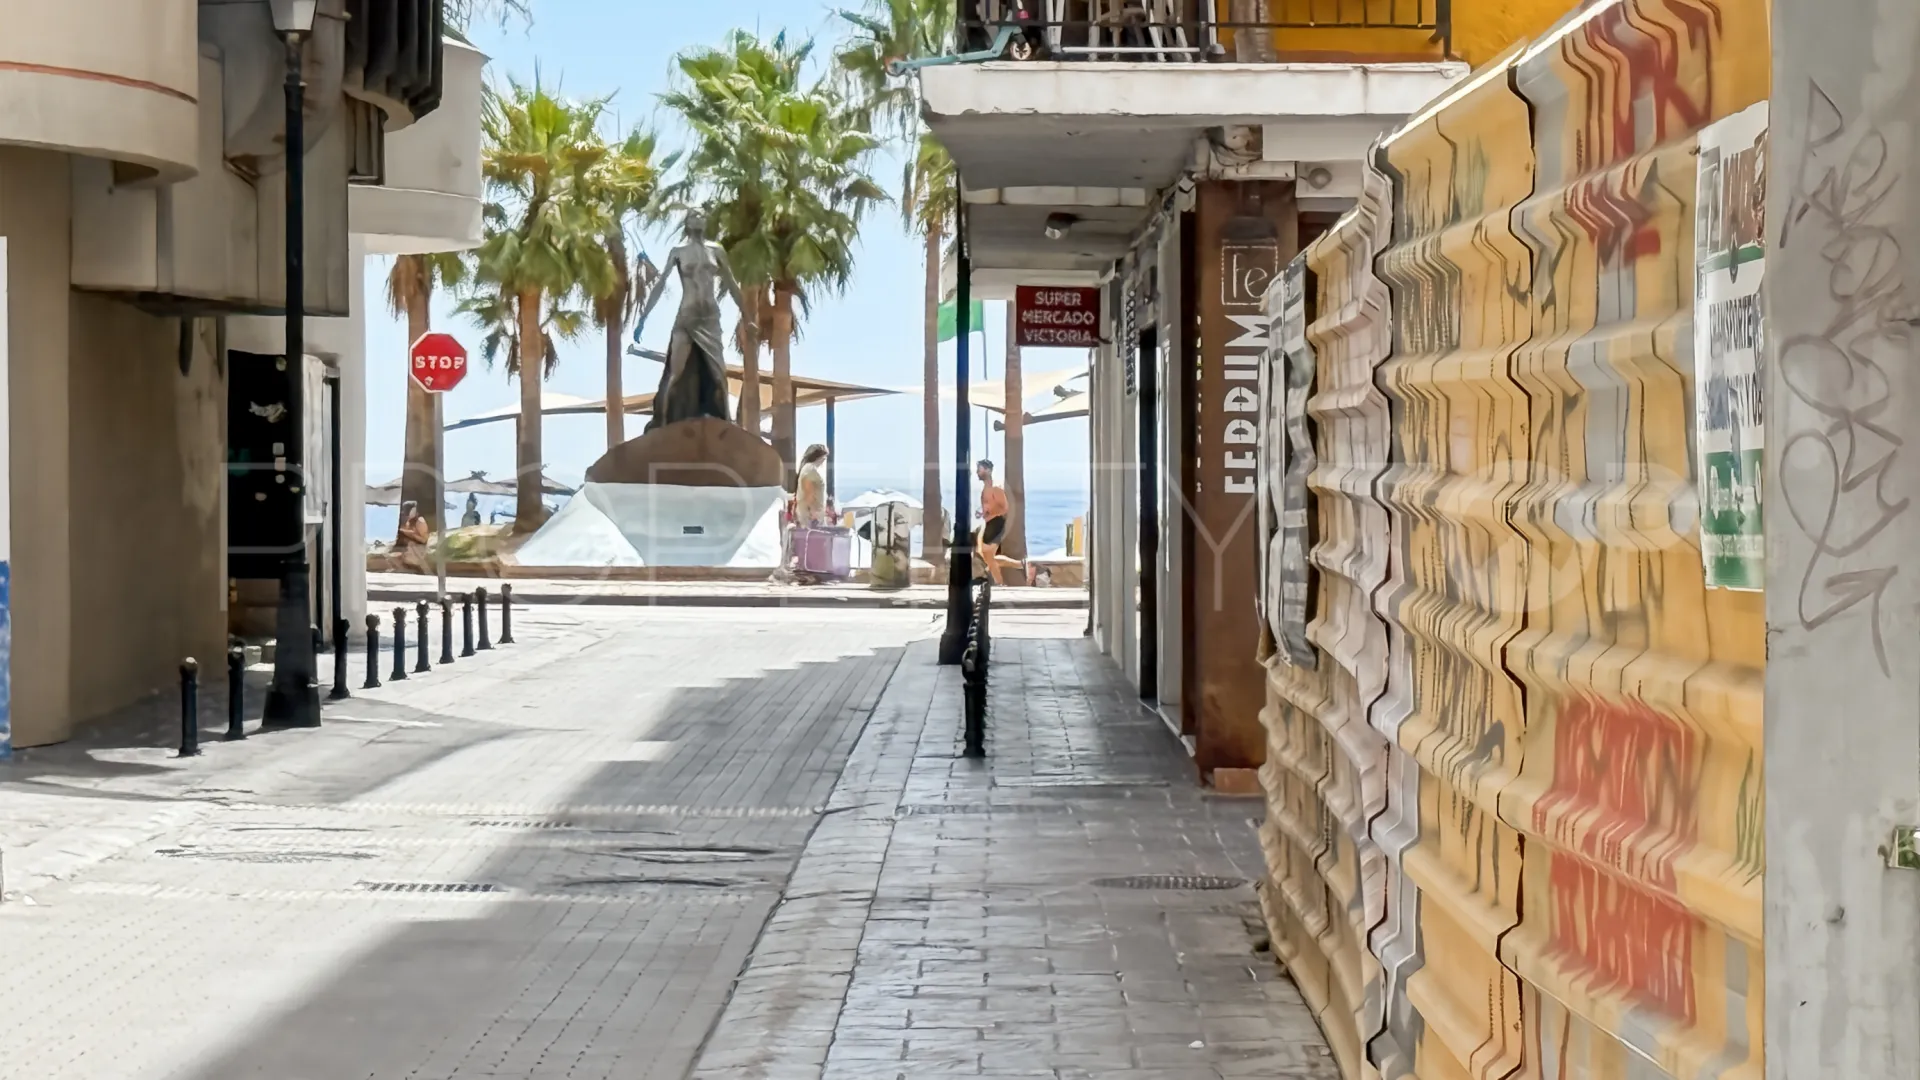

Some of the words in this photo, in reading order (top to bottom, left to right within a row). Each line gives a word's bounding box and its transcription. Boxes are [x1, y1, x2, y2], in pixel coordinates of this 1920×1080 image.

[1034, 291, 1082, 306] SUPER
[1021, 309, 1096, 325] MERCADO
[1023, 328, 1092, 342] VICTORIA
[415, 355, 465, 370] STOP
